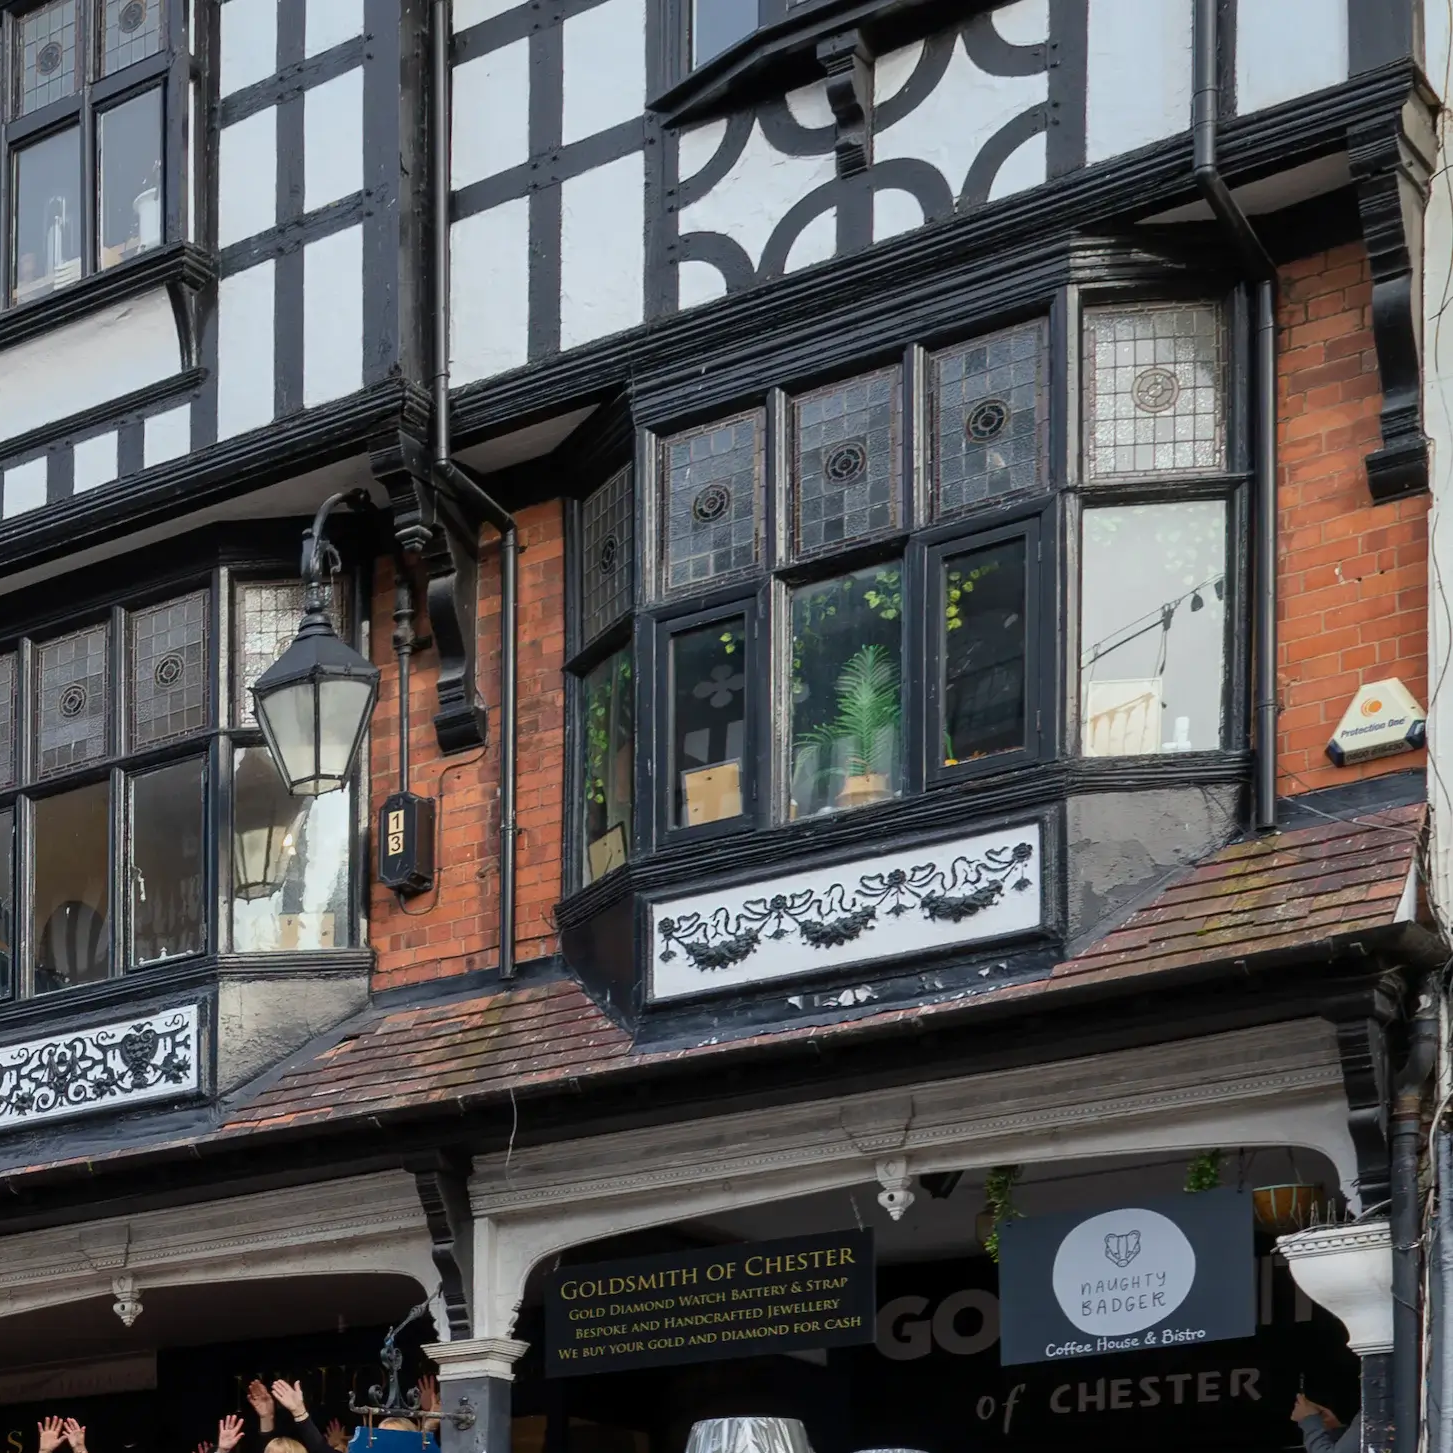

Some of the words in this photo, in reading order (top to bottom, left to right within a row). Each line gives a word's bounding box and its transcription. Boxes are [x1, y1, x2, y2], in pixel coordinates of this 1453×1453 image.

[1340, 721, 1386, 738] Protection
[1388, 718, 1405, 728] One
[560, 1267, 698, 1300] GOLDSMITH
[706, 1262, 737, 1282] OF
[745, 1247, 856, 1277] CHESTER
[1080, 1271, 1167, 1296] NAUGHTY
[568, 1307, 605, 1321] GOLD
[610, 1298, 675, 1316] DIAMOND
[679, 1291, 726, 1307] WATCH
[731, 1284, 788, 1301] BATTERY
[790, 1281, 802, 1294] &
[806, 1276, 849, 1292] STRAP
[575, 1324, 627, 1340] BESPOKE
[631, 1320, 660, 1333] AND
[664, 1307, 763, 1330] HANDCRAFTED
[767, 1298, 841, 1319] JEWELLERY
[1081, 1292, 1167, 1316] BADGER
[558, 1348, 579, 1360] WE
[582, 1345, 607, 1358] BUY
[609, 1341, 644, 1355] YOUR
[647, 1336, 684, 1350] GOLD
[688, 1332, 717, 1346] AND
[721, 1325, 790, 1342] DIAMOND
[793, 1320, 821, 1334] FOR
[824, 1316, 862, 1330] CASH
[1045, 1342, 1093, 1358] Coffee
[1096, 1337, 1140, 1352] House
[1144, 1332, 1157, 1345] &
[1162, 1328, 1206, 1344] Bistro
[976, 1383, 1026, 1434] of
[1049, 1368, 1262, 1414] CHESTER
